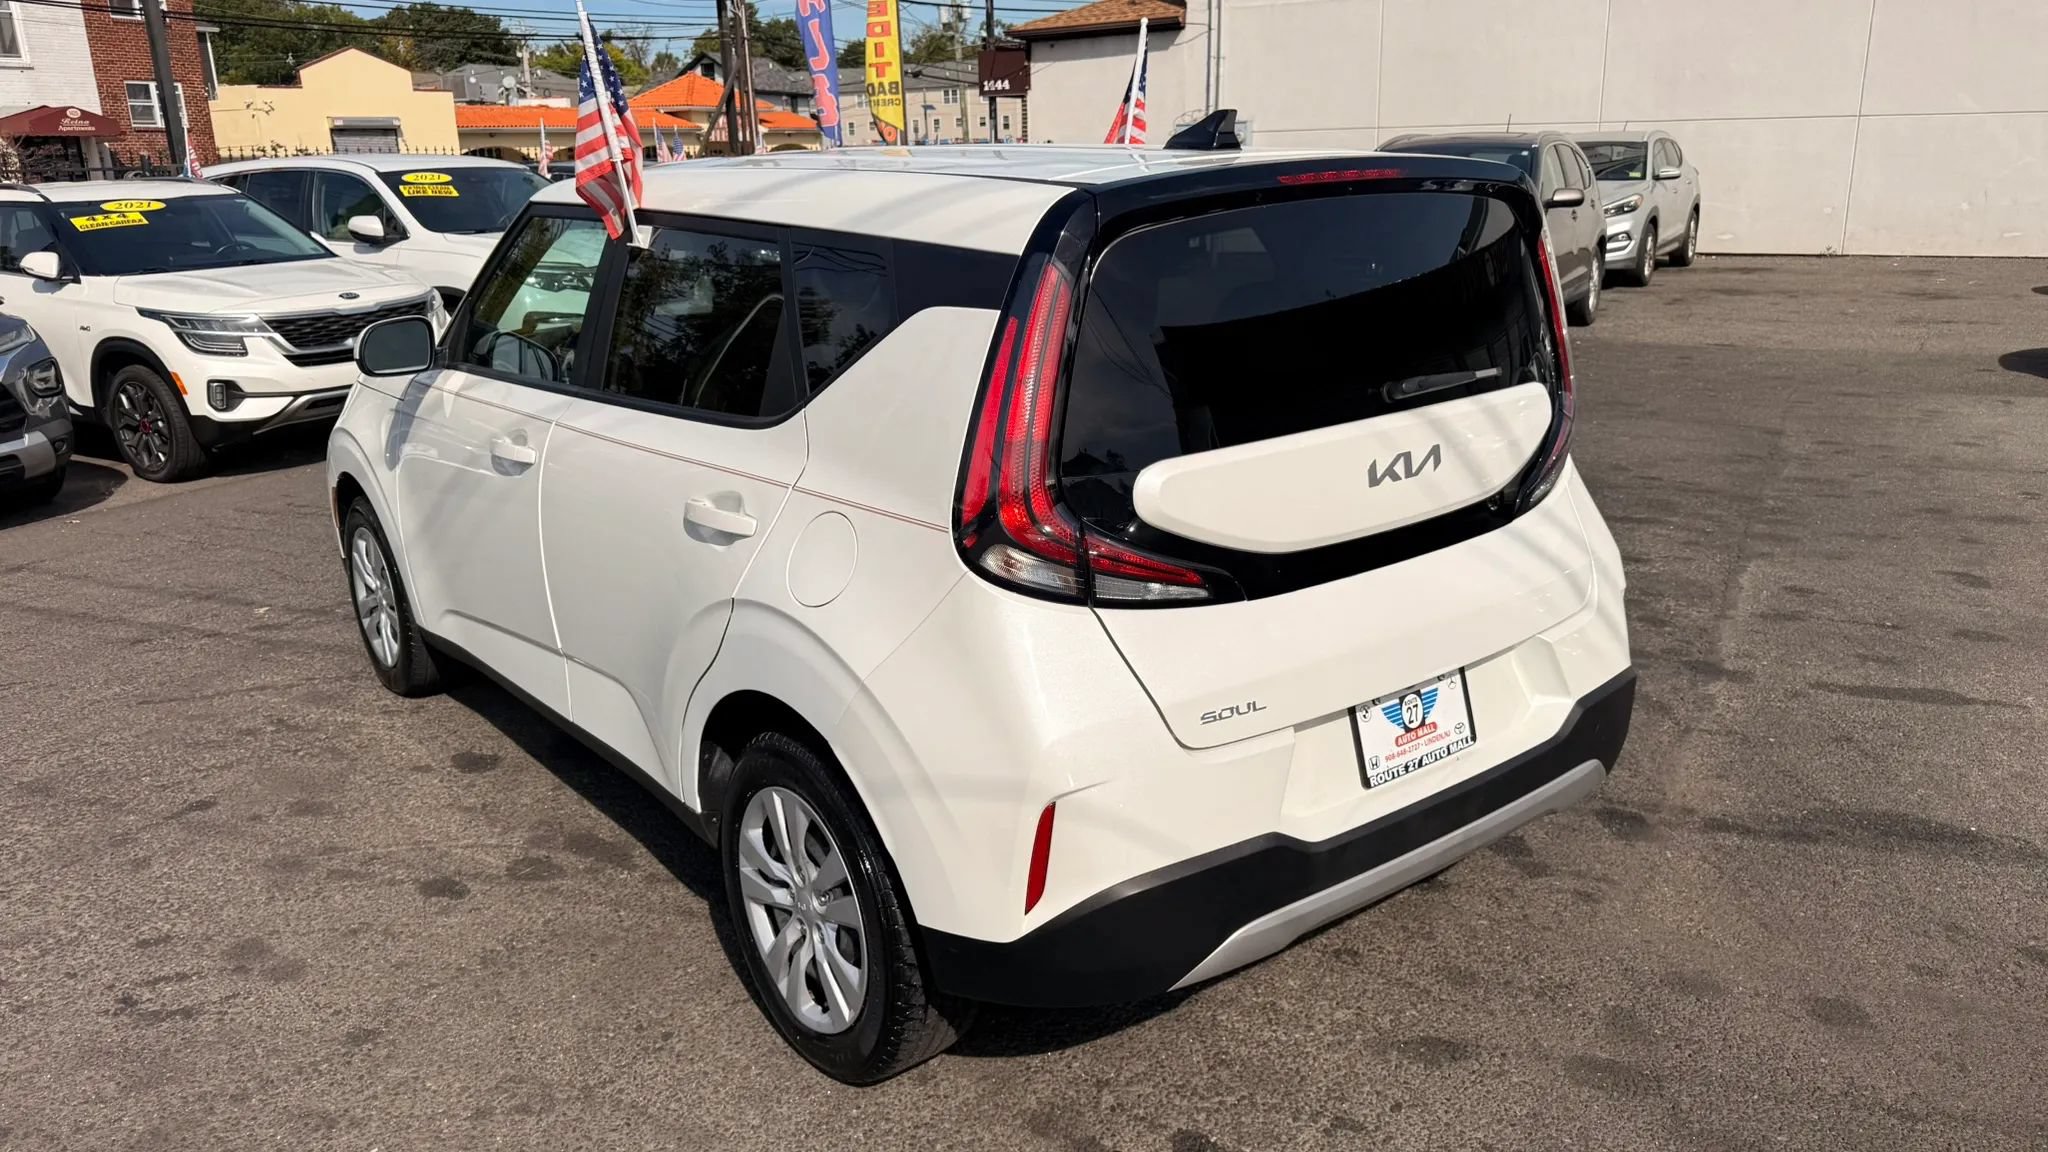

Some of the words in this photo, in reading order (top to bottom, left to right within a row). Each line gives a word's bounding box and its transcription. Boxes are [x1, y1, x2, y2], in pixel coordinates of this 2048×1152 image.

[114, 201, 153, 209] 2021
[1367, 443, 1442, 489] KIA
[1404, 696, 1418, 706] ROUTE
[1200, 700, 1267, 725] SOUL
[1406, 703, 1419, 725] 27
[1397, 731, 1417, 746] AUTO
[1417, 724, 1436, 739] MALL
[1369, 763, 1406, 788] ROUTE
[1407, 758, 1420, 772] 27
[1421, 747, 1448, 766] AUTO
[1449, 736, 1475, 754] MALL
